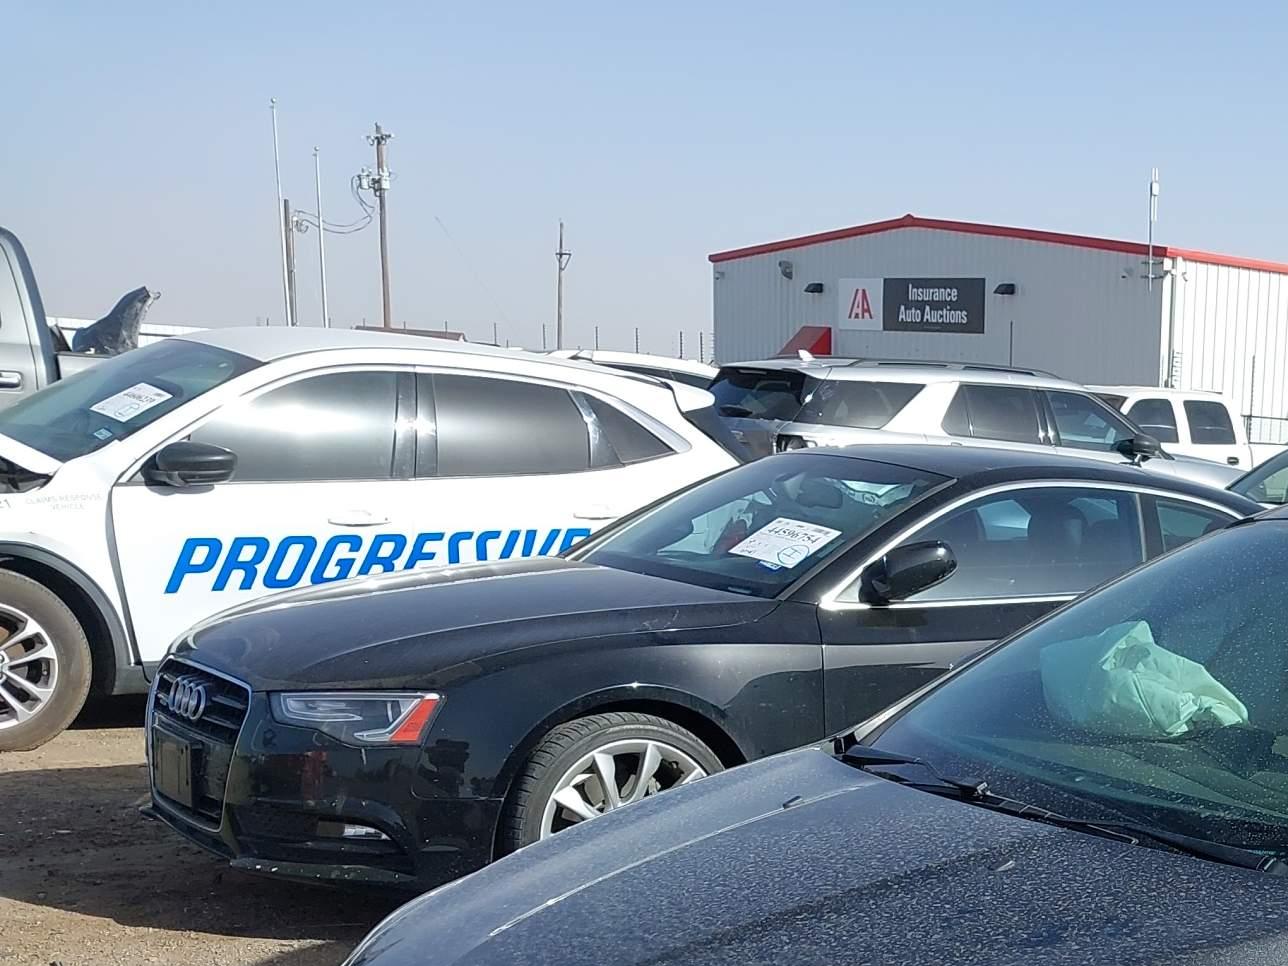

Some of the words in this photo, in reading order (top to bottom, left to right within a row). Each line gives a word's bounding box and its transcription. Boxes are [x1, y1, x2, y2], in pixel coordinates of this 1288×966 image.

[908, 283, 958, 302] Insurance
[898, 304, 922, 323] Auto
[923, 304, 968, 324] Auctions
